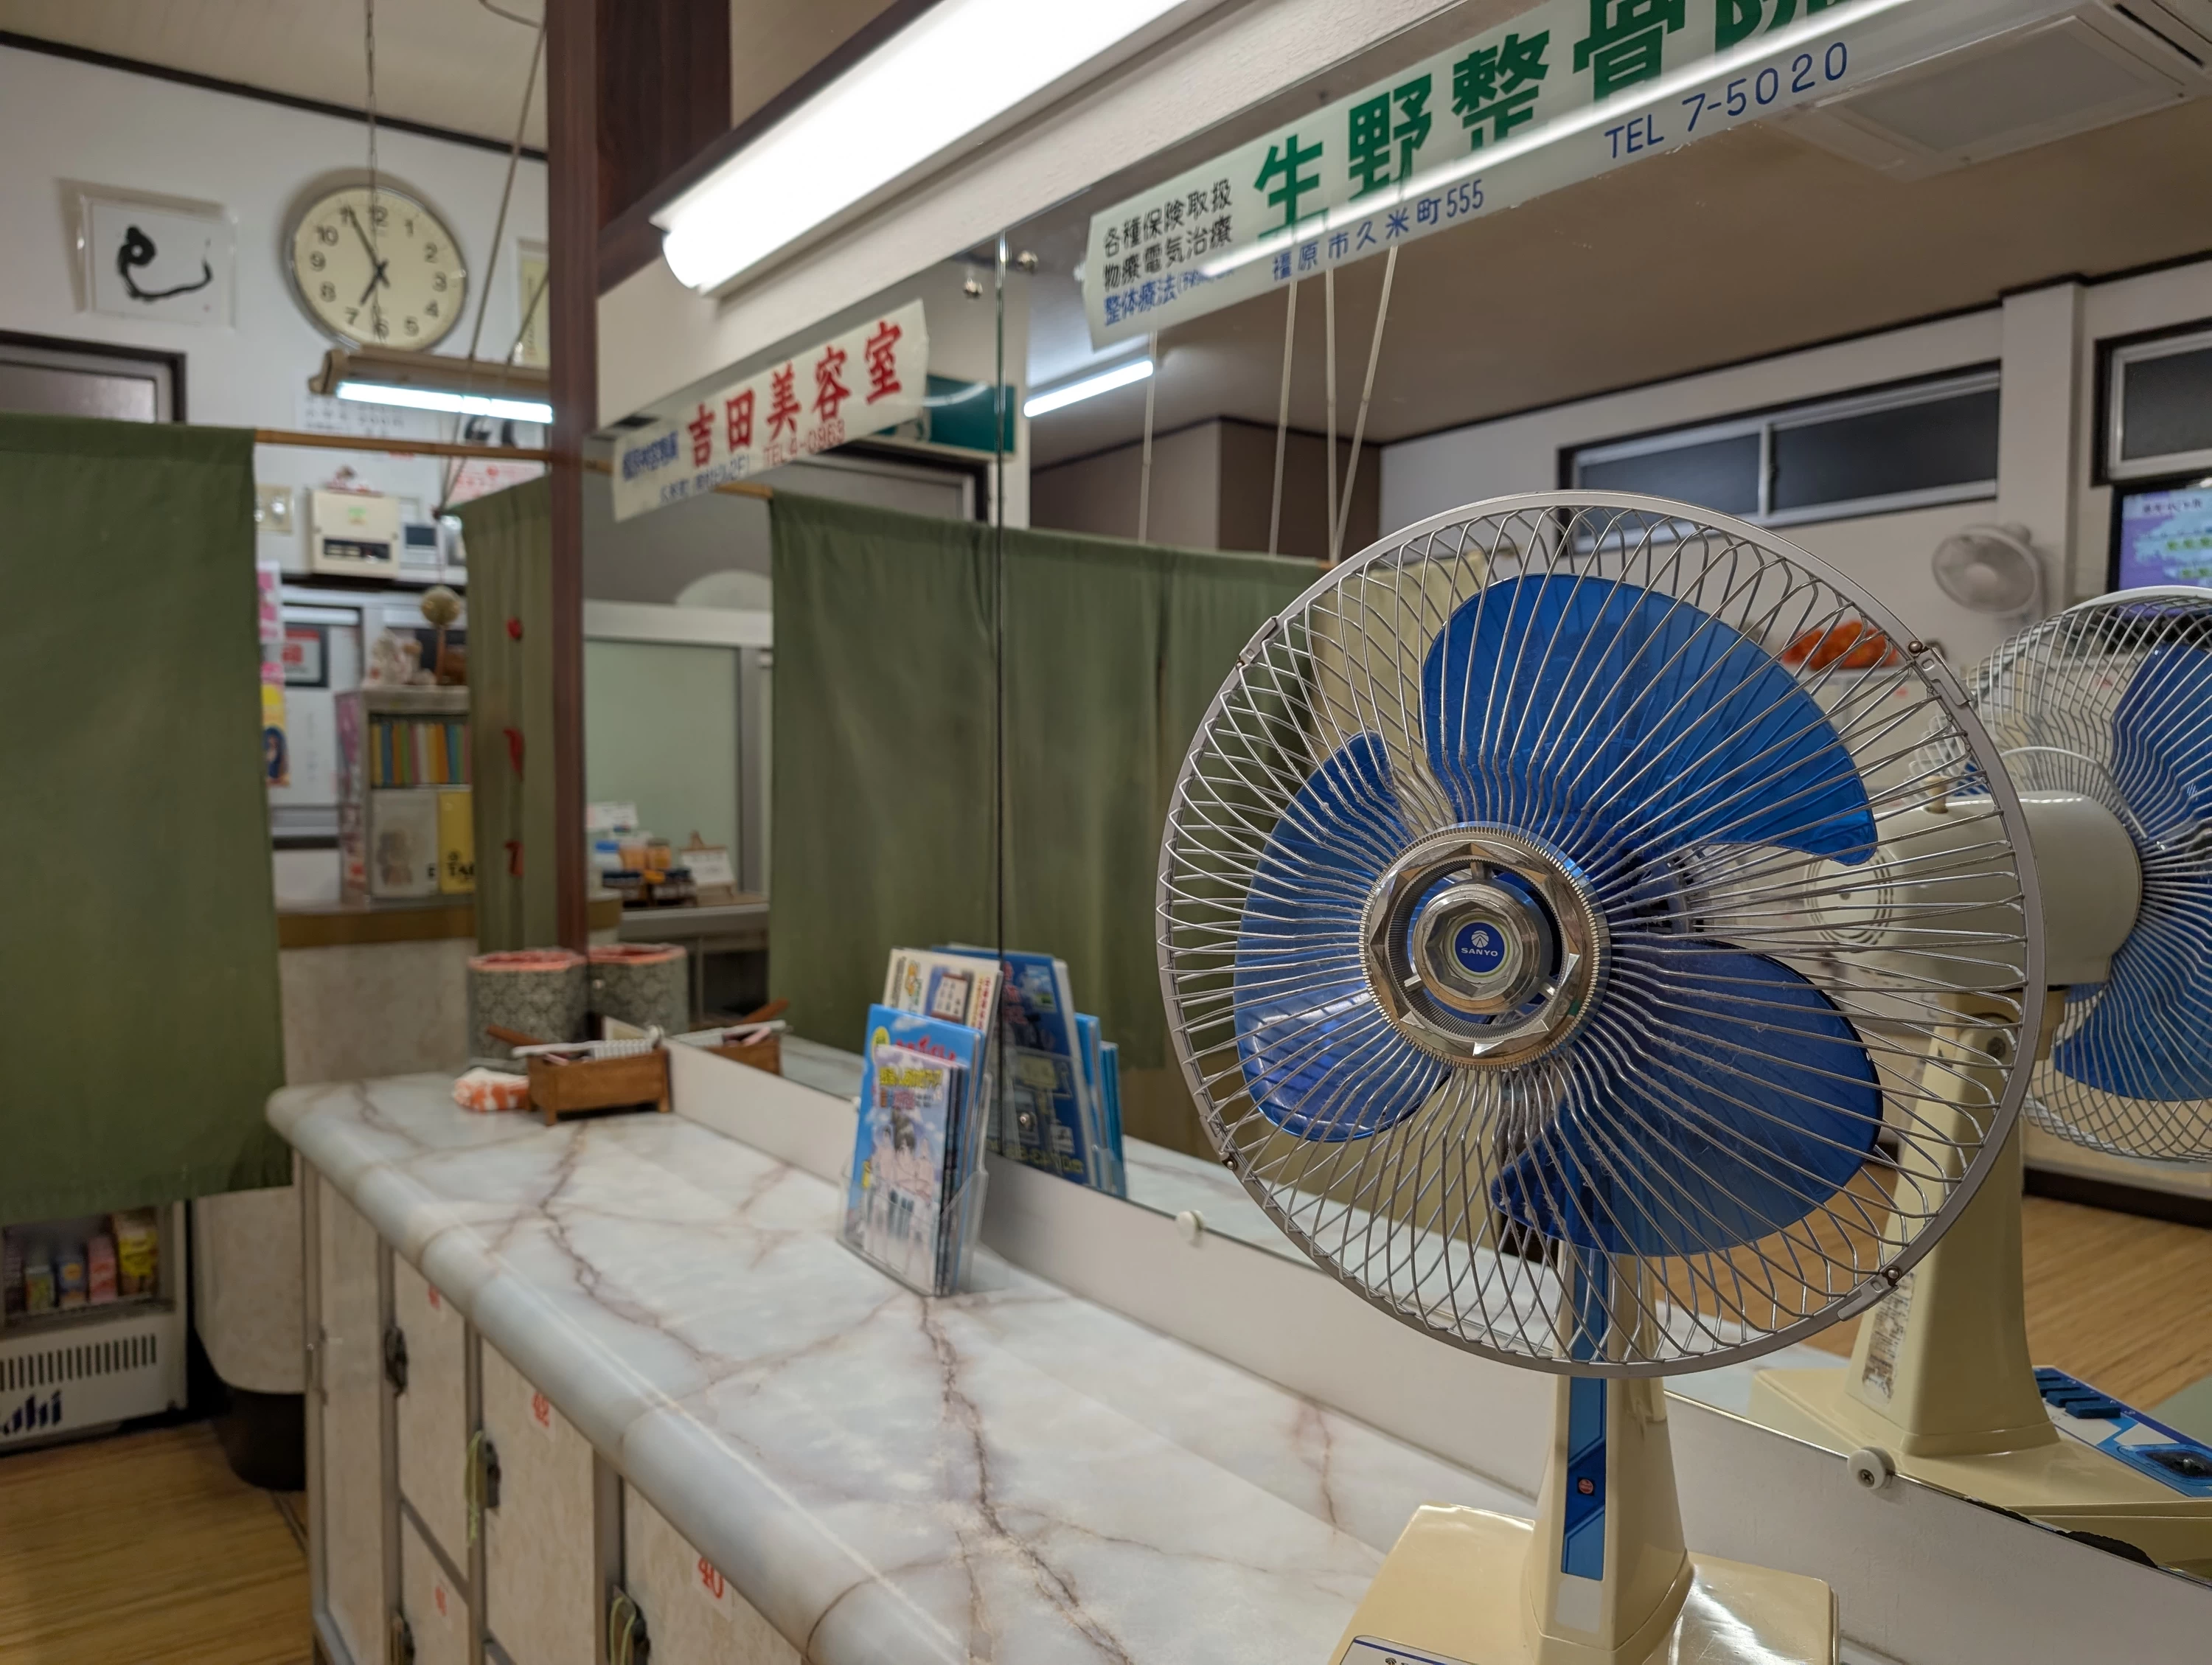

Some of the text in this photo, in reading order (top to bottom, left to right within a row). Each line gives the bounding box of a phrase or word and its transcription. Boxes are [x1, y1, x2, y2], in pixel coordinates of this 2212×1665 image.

[1604, 41, 1848, 159] TEL 7-5020
[1103, 177, 1233, 259] 各種保険取扱
[315, 224, 339, 247] 10
[310, 249, 327, 272] 9
[424, 242, 438, 263] 2
[319, 280, 337, 303] 8
[432, 271, 448, 293] 3
[344, 306, 361, 326] 7
[424, 300, 439, 319] 4
[403, 315, 420, 337] 5
[687, 321, 902, 467] 吉田美容室
[1461, 948, 1498, 957] SANYO
